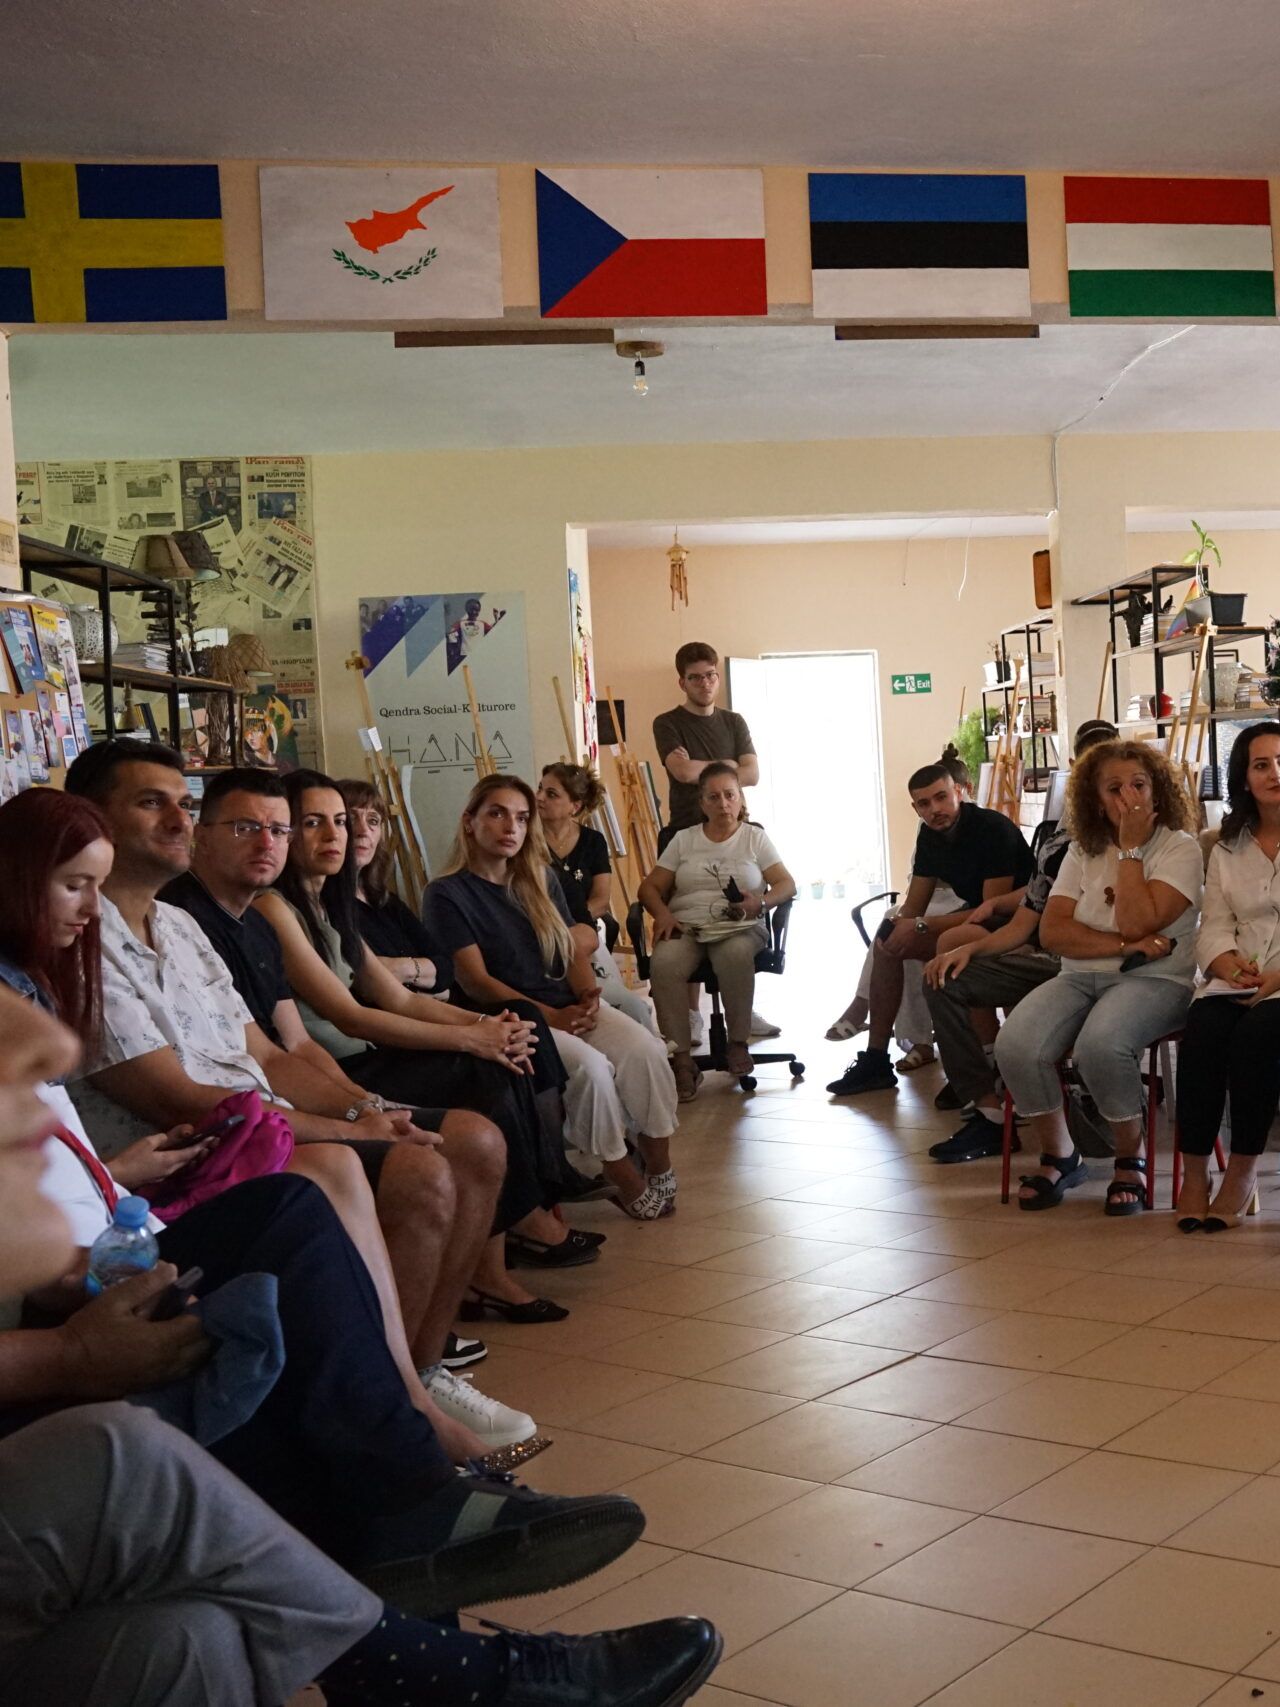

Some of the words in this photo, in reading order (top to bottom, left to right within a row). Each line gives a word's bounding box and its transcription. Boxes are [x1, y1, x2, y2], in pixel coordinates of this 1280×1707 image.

[917, 680, 931, 689] Exit
[379, 706, 421, 718] Qendra
[423, 702, 516, 716] Social-Klturore
